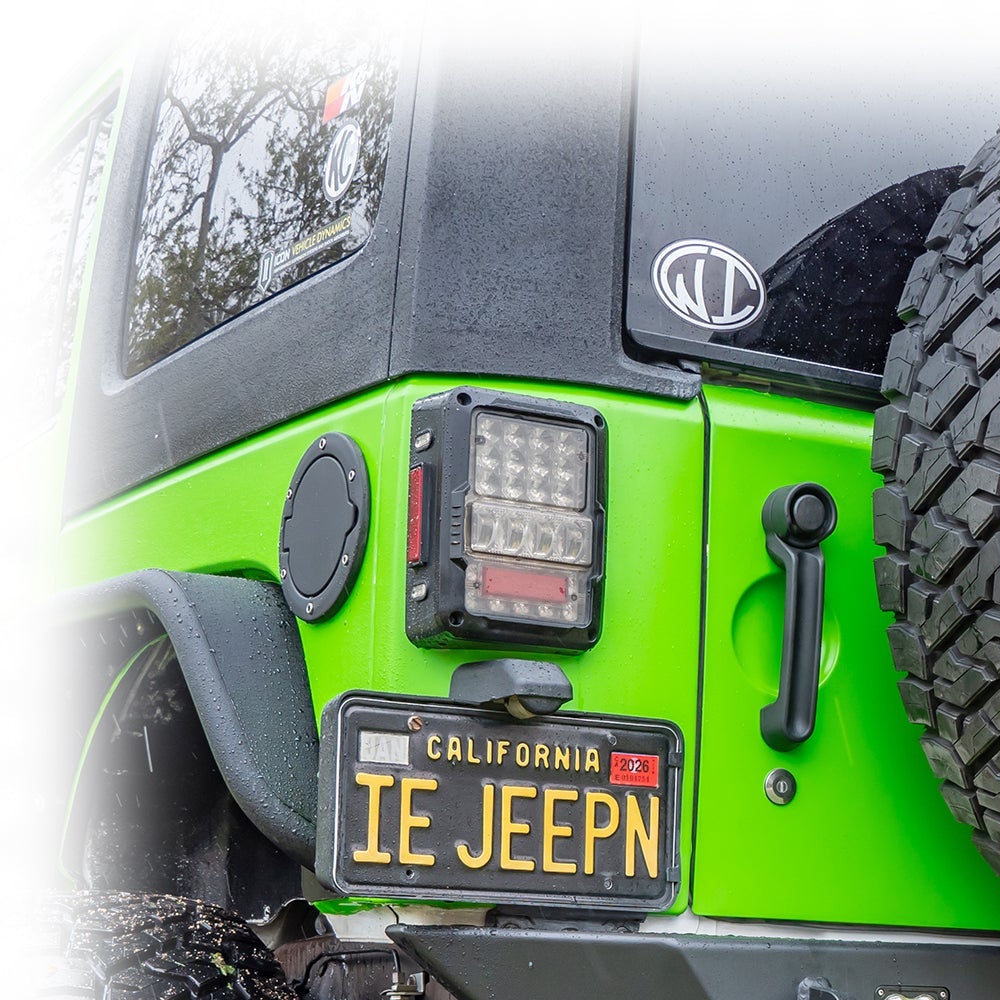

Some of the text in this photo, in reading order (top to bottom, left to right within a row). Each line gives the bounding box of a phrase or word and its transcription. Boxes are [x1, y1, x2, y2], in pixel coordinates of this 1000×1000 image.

[327, 129, 353, 191] KC
[273, 248, 292, 267] ICON
[292, 233, 319, 256] VEHICLE
[316, 215, 351, 244] DYNAMICS
[426, 734, 601, 773] CALIFORNIA
[620, 758, 649, 773] 2026
[353, 771, 660, 879] IE JEEPN
